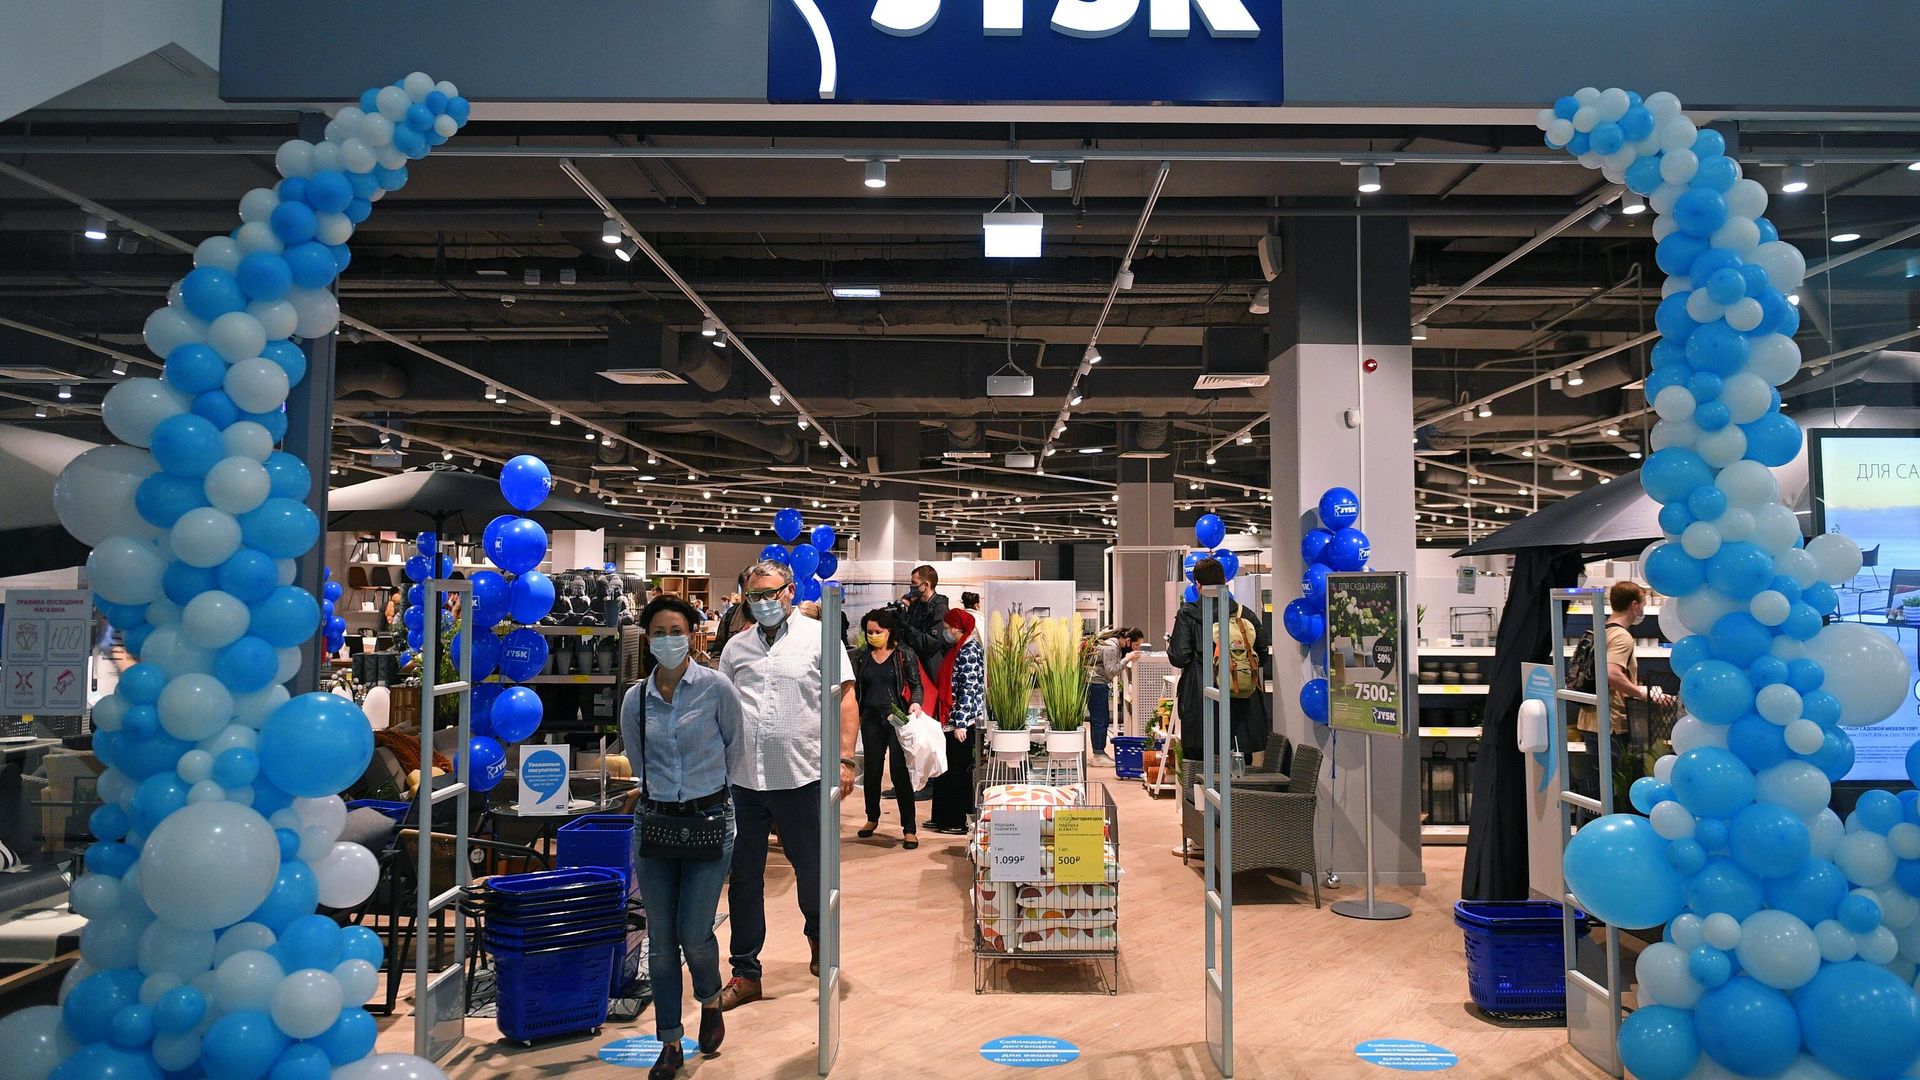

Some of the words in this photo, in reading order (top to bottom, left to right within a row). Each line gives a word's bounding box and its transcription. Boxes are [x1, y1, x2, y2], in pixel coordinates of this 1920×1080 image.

[1856, 463, 1890, 482] ДЛЯ
[1896, 463, 1920, 479] СА
[506, 650, 528, 658] JYSK
[1377, 653, 1392, 664] 50%
[1376, 710, 1396, 722] JYSK
